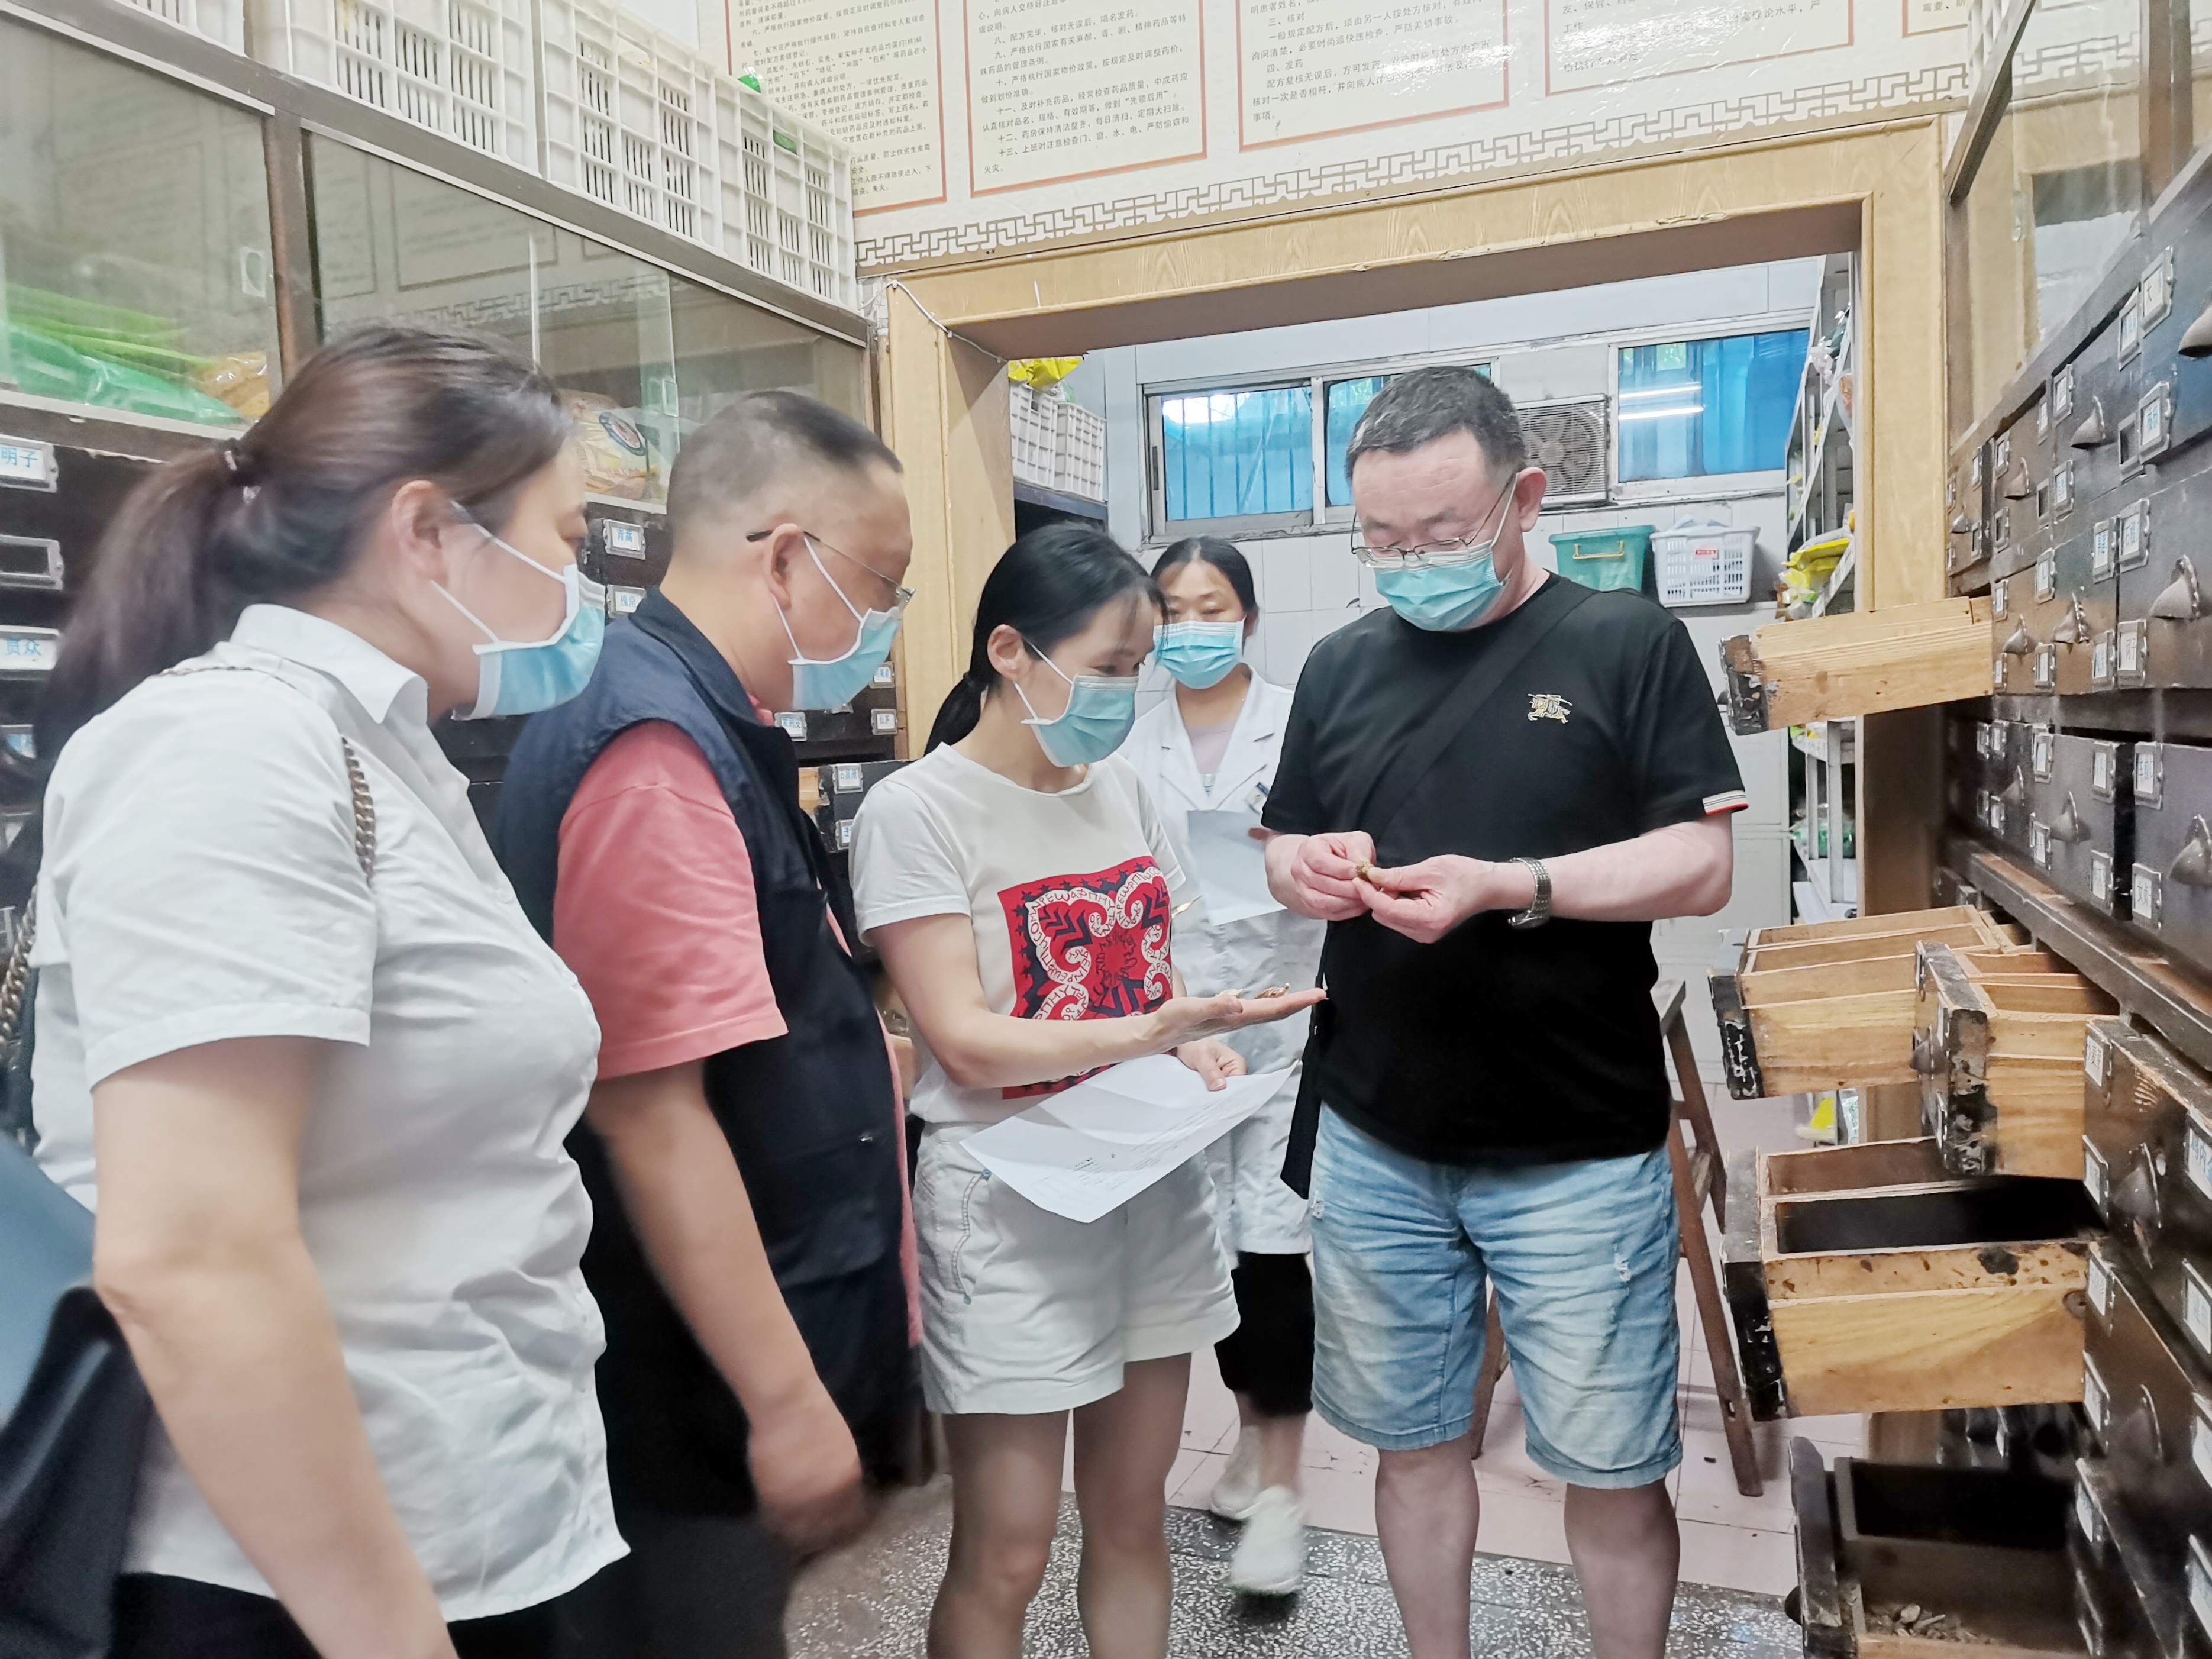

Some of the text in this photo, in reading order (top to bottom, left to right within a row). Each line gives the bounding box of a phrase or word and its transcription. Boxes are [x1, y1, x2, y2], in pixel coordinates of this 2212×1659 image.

[1250, 0, 1319, 14] 明患者姓名，
[1562, 0, 1635, 14] 发、保管、
[1268, 12, 1304, 27] 三、核对
[980, 56, 1049, 76] 殊药品的管理条例。
[1267, 59, 1303, 73] 四、发药
[826, 115, 912, 135] 及短缺药品应及时通知科室。
[984, 164, 1003, 174] 火灾。
